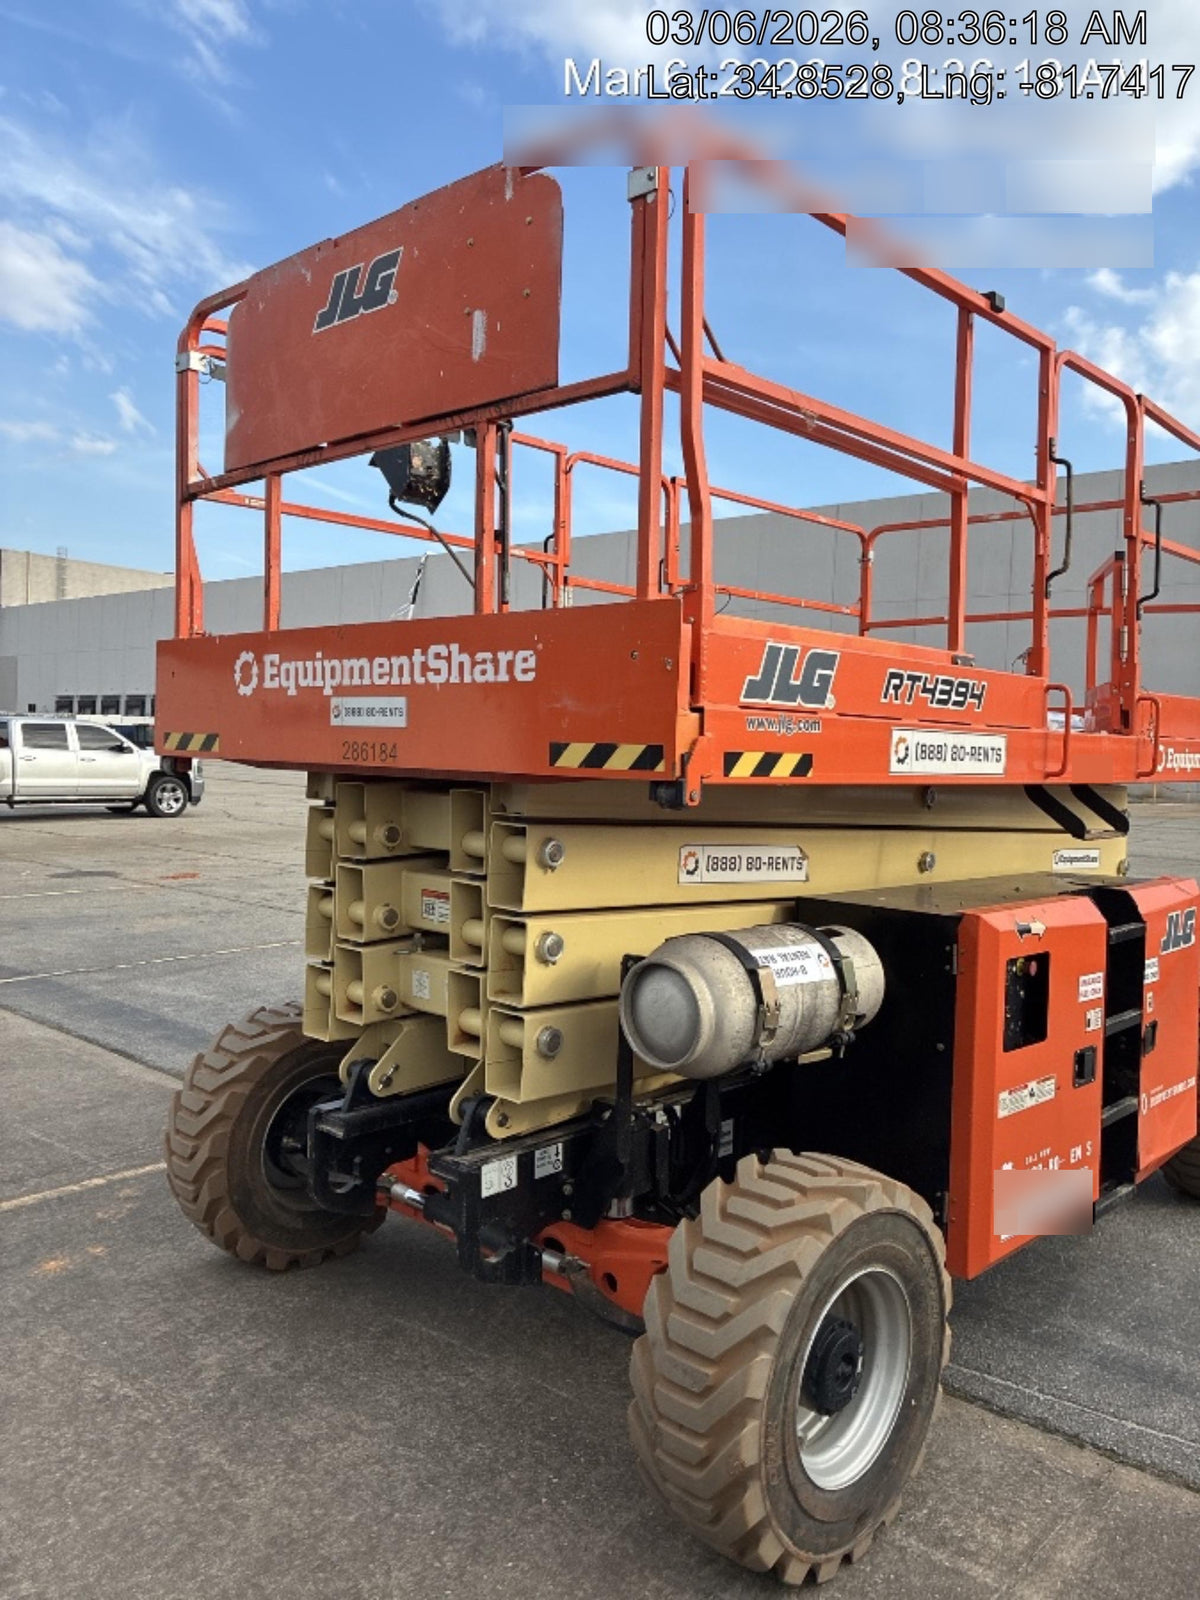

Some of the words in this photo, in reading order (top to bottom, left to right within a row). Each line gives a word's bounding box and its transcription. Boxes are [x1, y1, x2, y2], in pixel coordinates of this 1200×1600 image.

[312, 246, 404, 334] JLG
[262, 643, 537, 696] EquipmentShare
[740, 640, 840, 709] JLG
[881, 668, 987, 711] RT4394
[746, 714, 821, 735] www.jlg.com
[341, 740, 398, 762] 286184
[914, 743, 948, 762] (888)
[951, 746, 1002, 764] 80-RENTS
[706, 854, 742, 873] (888)
[746, 856, 803, 872] 80-RENTS
[1160, 906, 1197, 955] JLG
